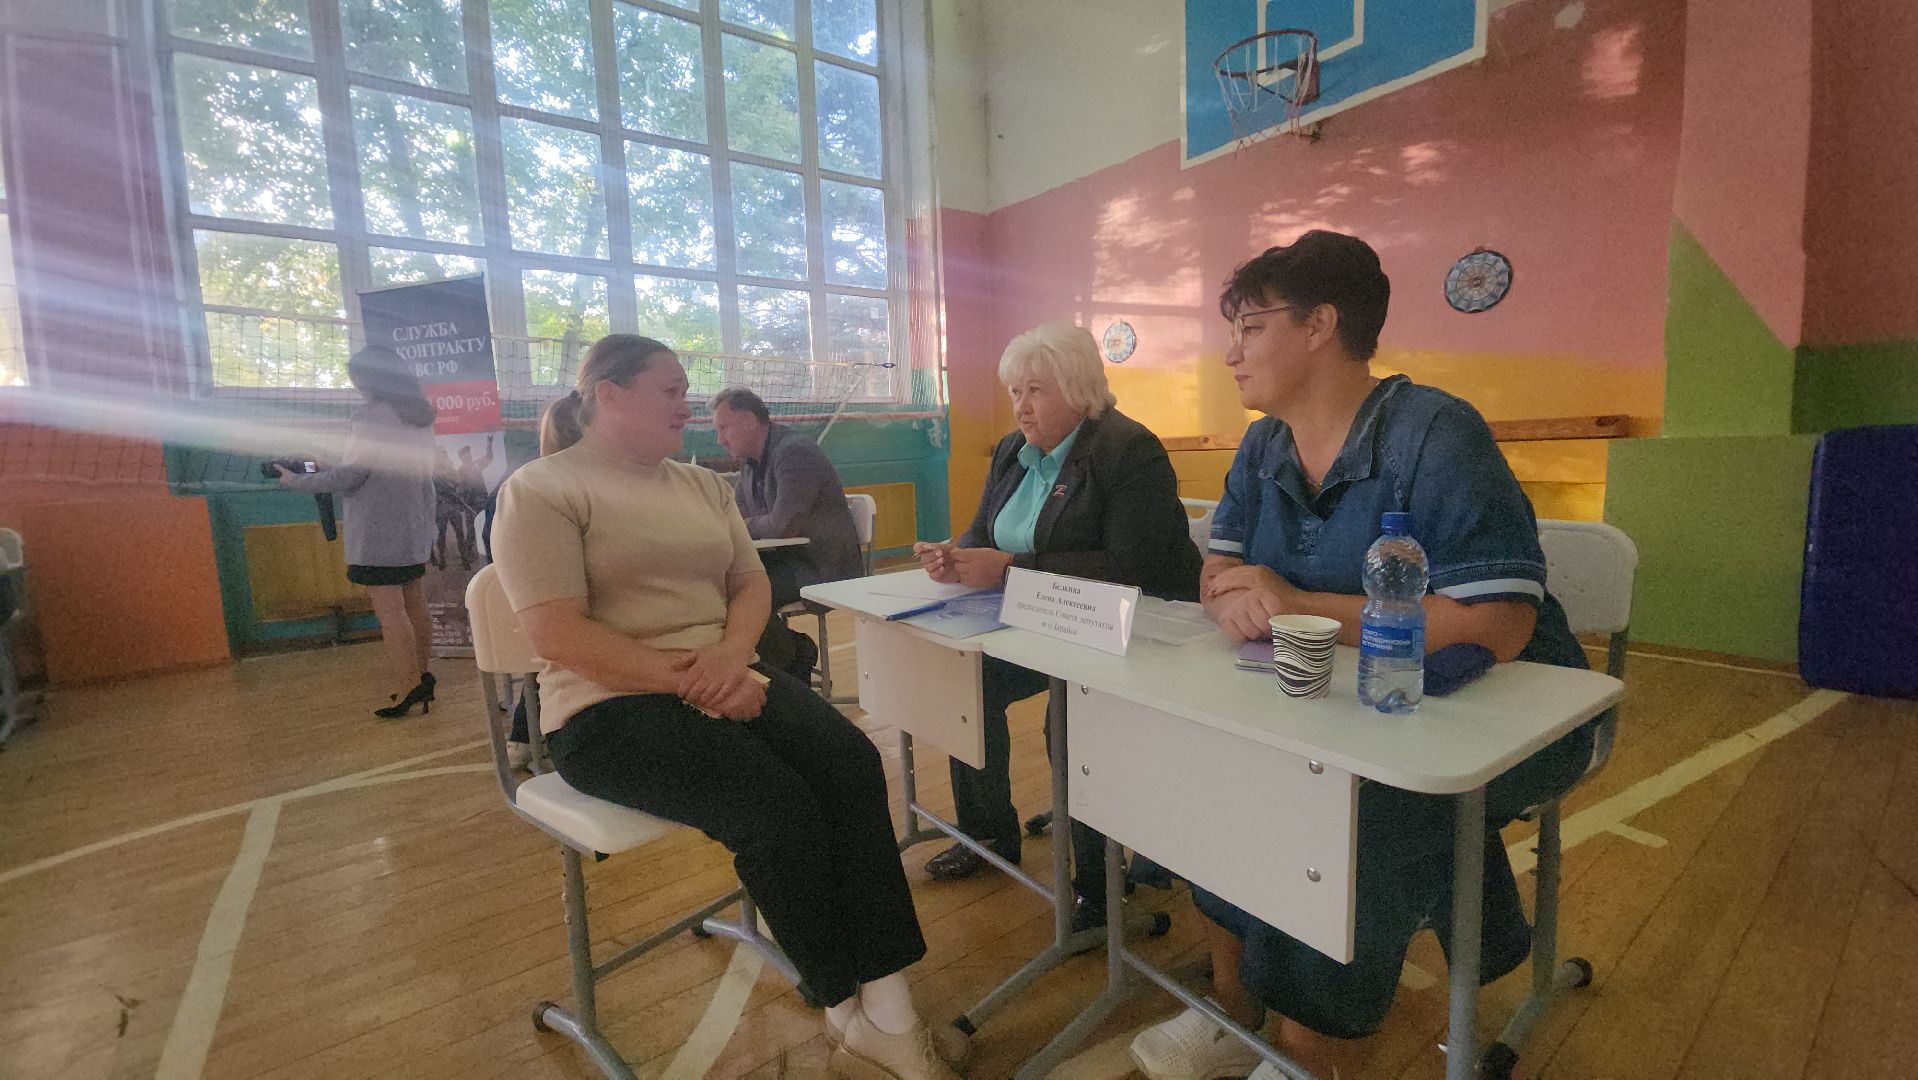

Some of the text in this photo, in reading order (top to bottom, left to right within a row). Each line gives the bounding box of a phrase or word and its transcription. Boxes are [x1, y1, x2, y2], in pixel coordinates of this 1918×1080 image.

[393, 322, 458, 342] СЛУЖБА
[396, 337, 486, 360] КОНТРАКТУ
[415, 359, 458, 377] ВС РФ
[437, 391, 495, 411] 000 руб.
[1056, 610, 1078, 622] Совета
[1080, 618, 1114, 631] депутатов
